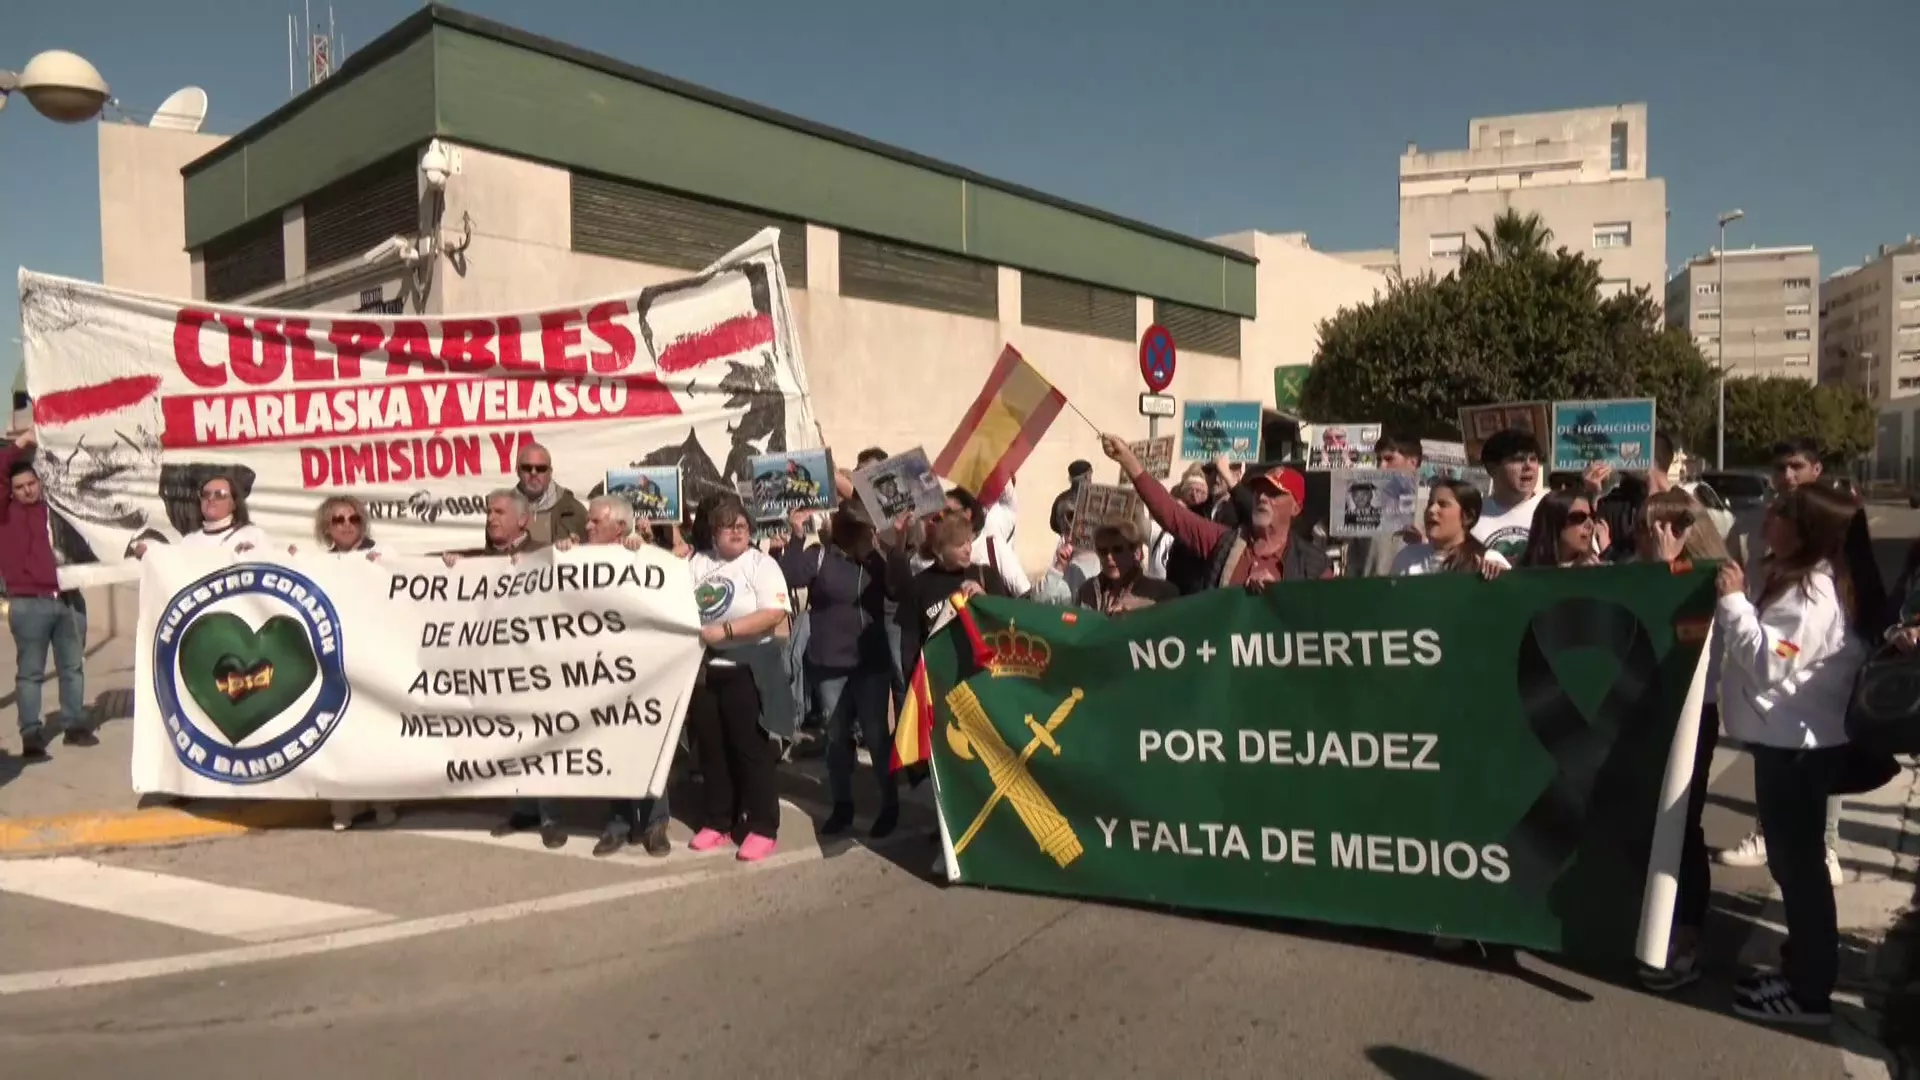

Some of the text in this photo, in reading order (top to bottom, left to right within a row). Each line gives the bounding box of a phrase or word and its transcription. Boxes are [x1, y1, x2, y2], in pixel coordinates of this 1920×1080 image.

[173, 301, 636, 387] CULPABLES
[193, 376, 628, 443] MARLASKA Y VELASCO
[1578, 422, 1651, 435] HOMICIDIO
[300, 429, 482, 489] DIMISIÓN
[388, 573, 448, 602] POR
[457, 573, 492, 602] LA
[493, 563, 666, 600] SEGURIDAD
[159, 572, 336, 655] NUESTRO CORAZON
[421, 610, 627, 648] DE NUESTROS
[1128, 628, 1443, 671] NO + MUERTES
[407, 652, 638, 696] AGENTES MÁS
[400, 697, 663, 741] MEDIOS, NO MÁS
[168, 711, 337, 777] POR BANDERA
[446, 748, 613, 784] MUERTES.
[1139, 729, 1441, 771] POR DEJADEZ
[1095, 816, 1511, 883] Y FALTA DE MEDIOS
